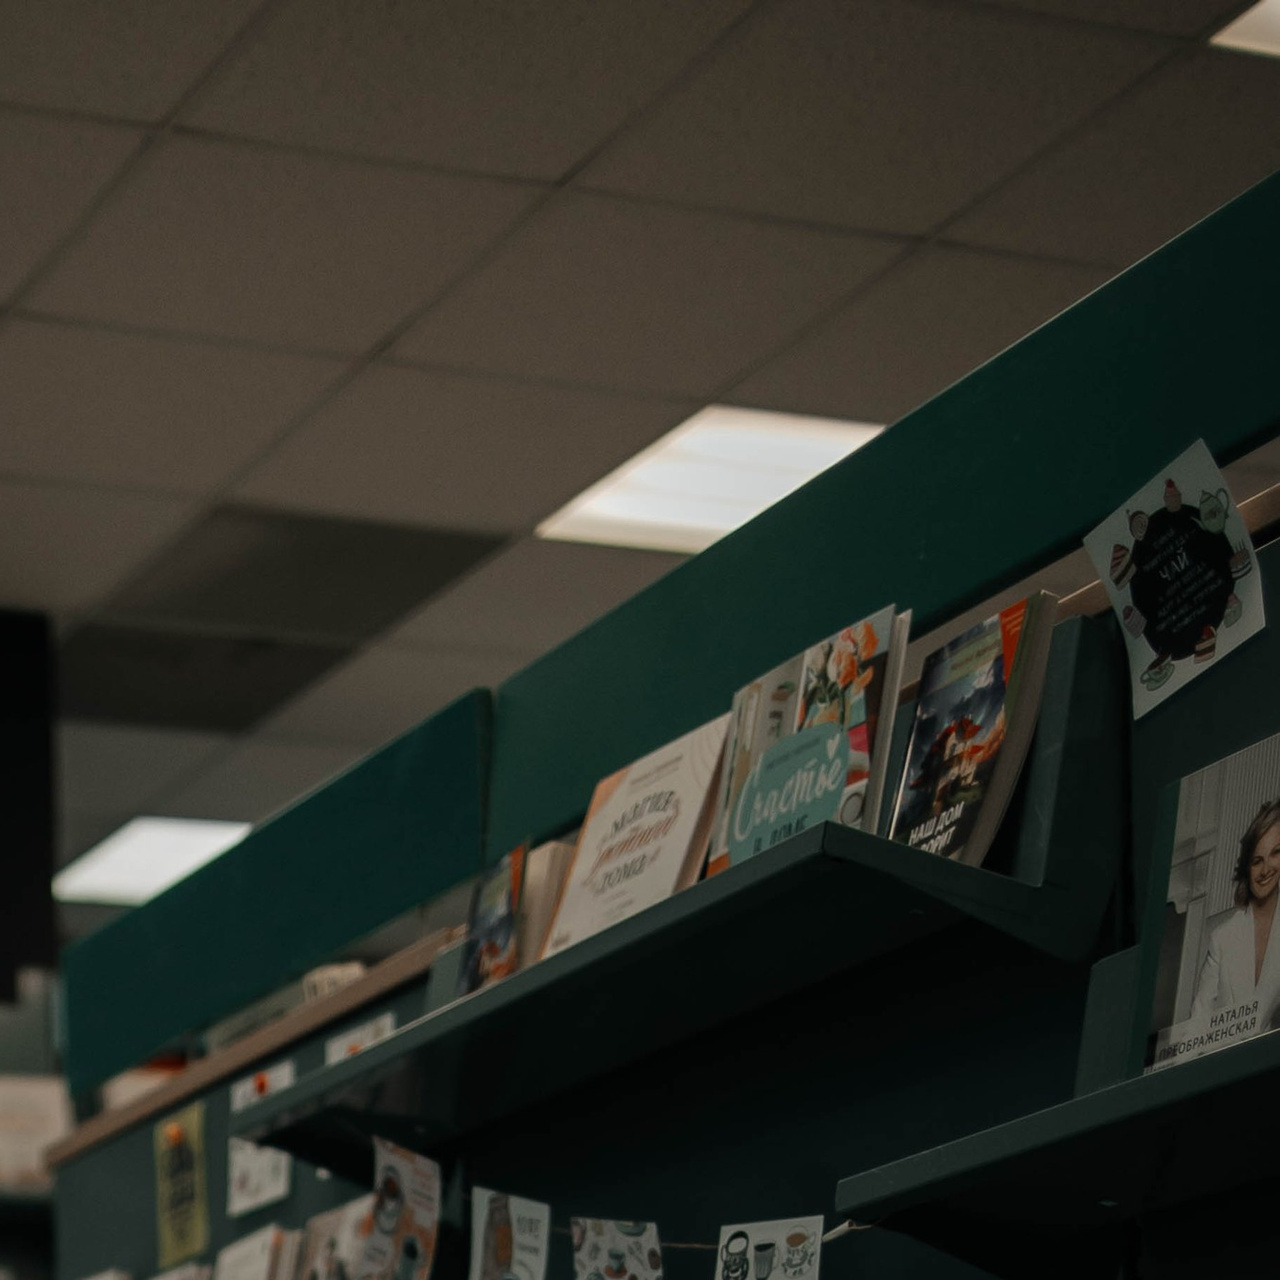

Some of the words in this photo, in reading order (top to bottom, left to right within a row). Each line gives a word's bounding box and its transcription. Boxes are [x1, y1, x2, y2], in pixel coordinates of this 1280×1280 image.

[908, 815, 938, 847] НАШ
[934, 800, 966, 836] ДОМ
[1209, 1000, 1260, 1029] НАТАЛЬЯ
[1158, 1016, 1258, 1062] ПРЕОБРАЖЕНСКАЯ
